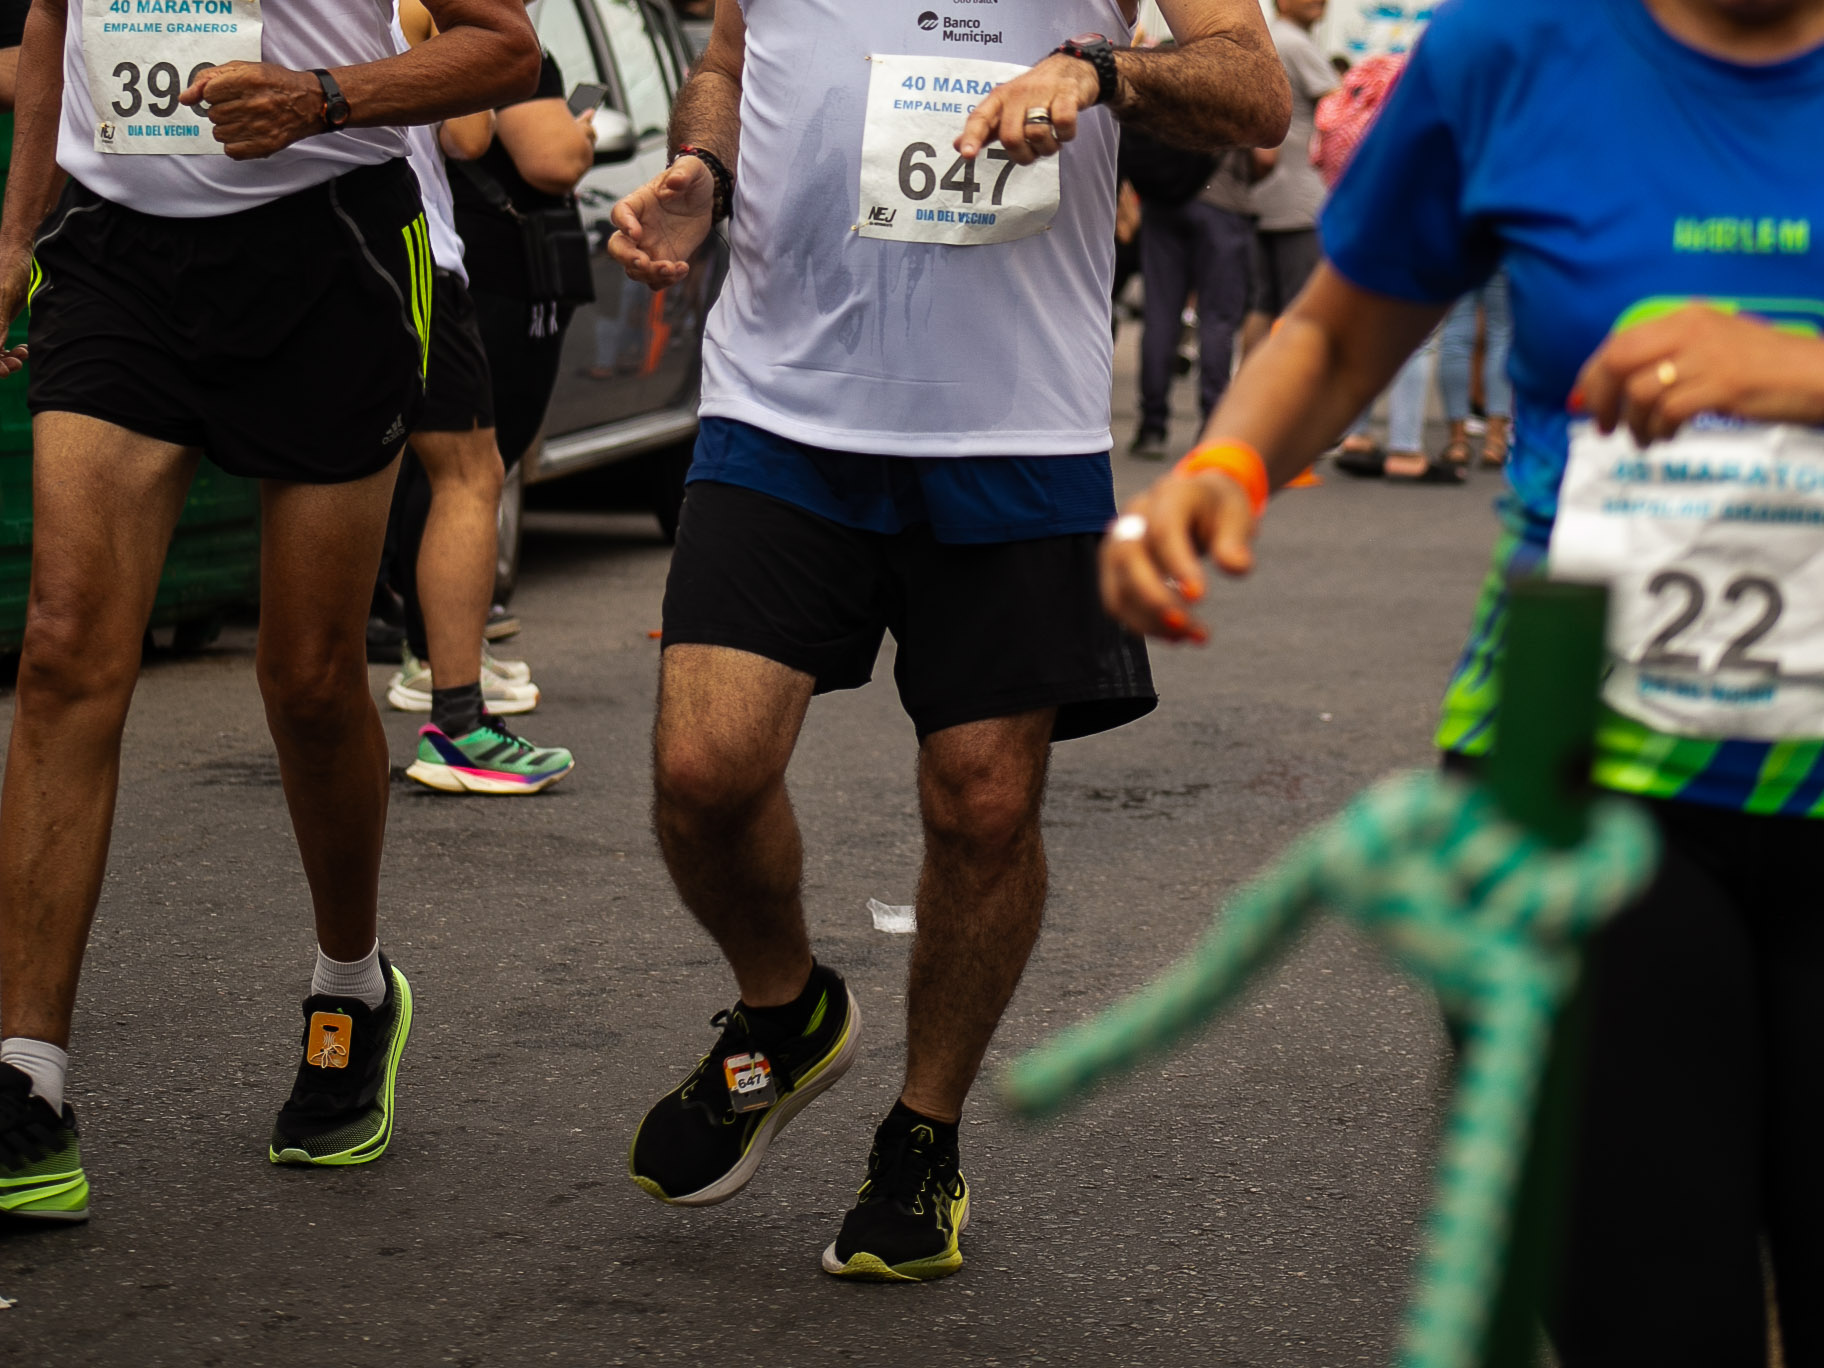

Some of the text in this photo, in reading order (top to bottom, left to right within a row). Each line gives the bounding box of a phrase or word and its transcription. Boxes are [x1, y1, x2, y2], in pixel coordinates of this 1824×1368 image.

[109, 0, 233, 14] 40 MARATON
[104, 23, 238, 33] EMPALME GRANEROS
[943, 16, 980, 29] Banco
[943, 30, 1003, 45] Municipal
[902, 76, 1003, 95] 40 MARA
[893, 99, 962, 113] EMPALME
[128, 125, 200, 136] DIA DEL VECINO
[898, 141, 1016, 206] 647
[868, 206, 897, 222] NEJ
[915, 208, 997, 226] DIA DEL VECINO
[1639, 569, 1783, 672] 22
[737, 1074, 762, 1089] 647
